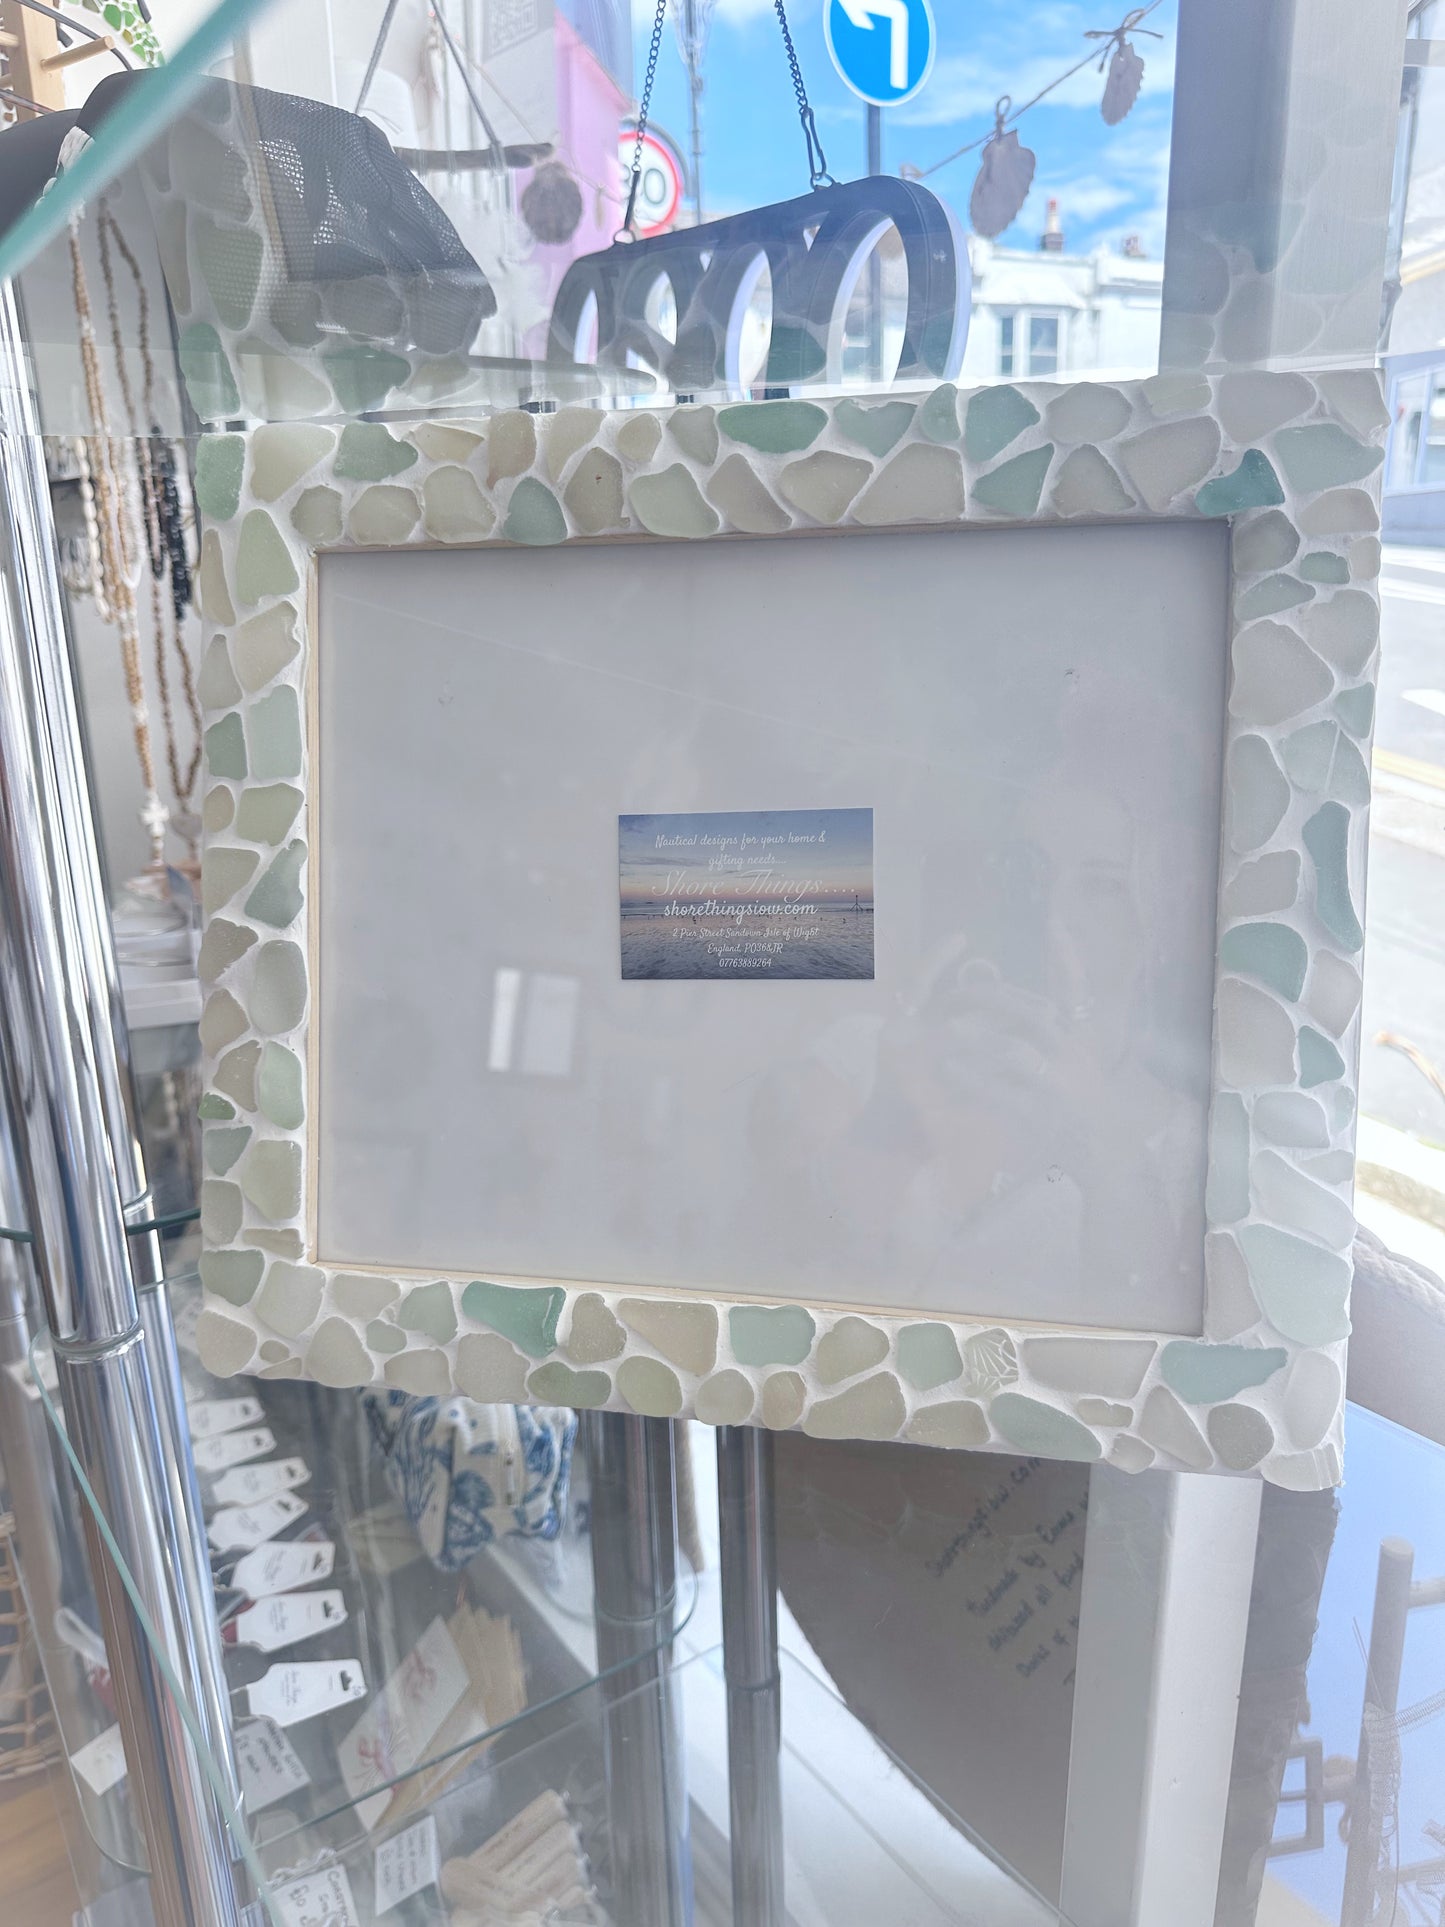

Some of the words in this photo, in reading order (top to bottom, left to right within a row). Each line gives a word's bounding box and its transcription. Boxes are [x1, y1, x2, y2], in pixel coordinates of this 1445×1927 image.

[655, 833, 698, 849] Nautical
[699, 833, 738, 851] designs
[740, 833, 759, 851] for
[760, 834, 785, 849] your
[787, 831, 817, 844] home
[818, 829, 827, 843] &
[708, 853, 745, 872] gifting
[651, 869, 724, 896] Shore
[663, 899, 819, 925] shorethingsiow.com
[672, 927, 678, 937] 2
[680, 927, 697, 938] Pier
[763, 927, 781, 938] Isle
[782, 928, 791, 941] of
[793, 926, 820, 941] Wight
